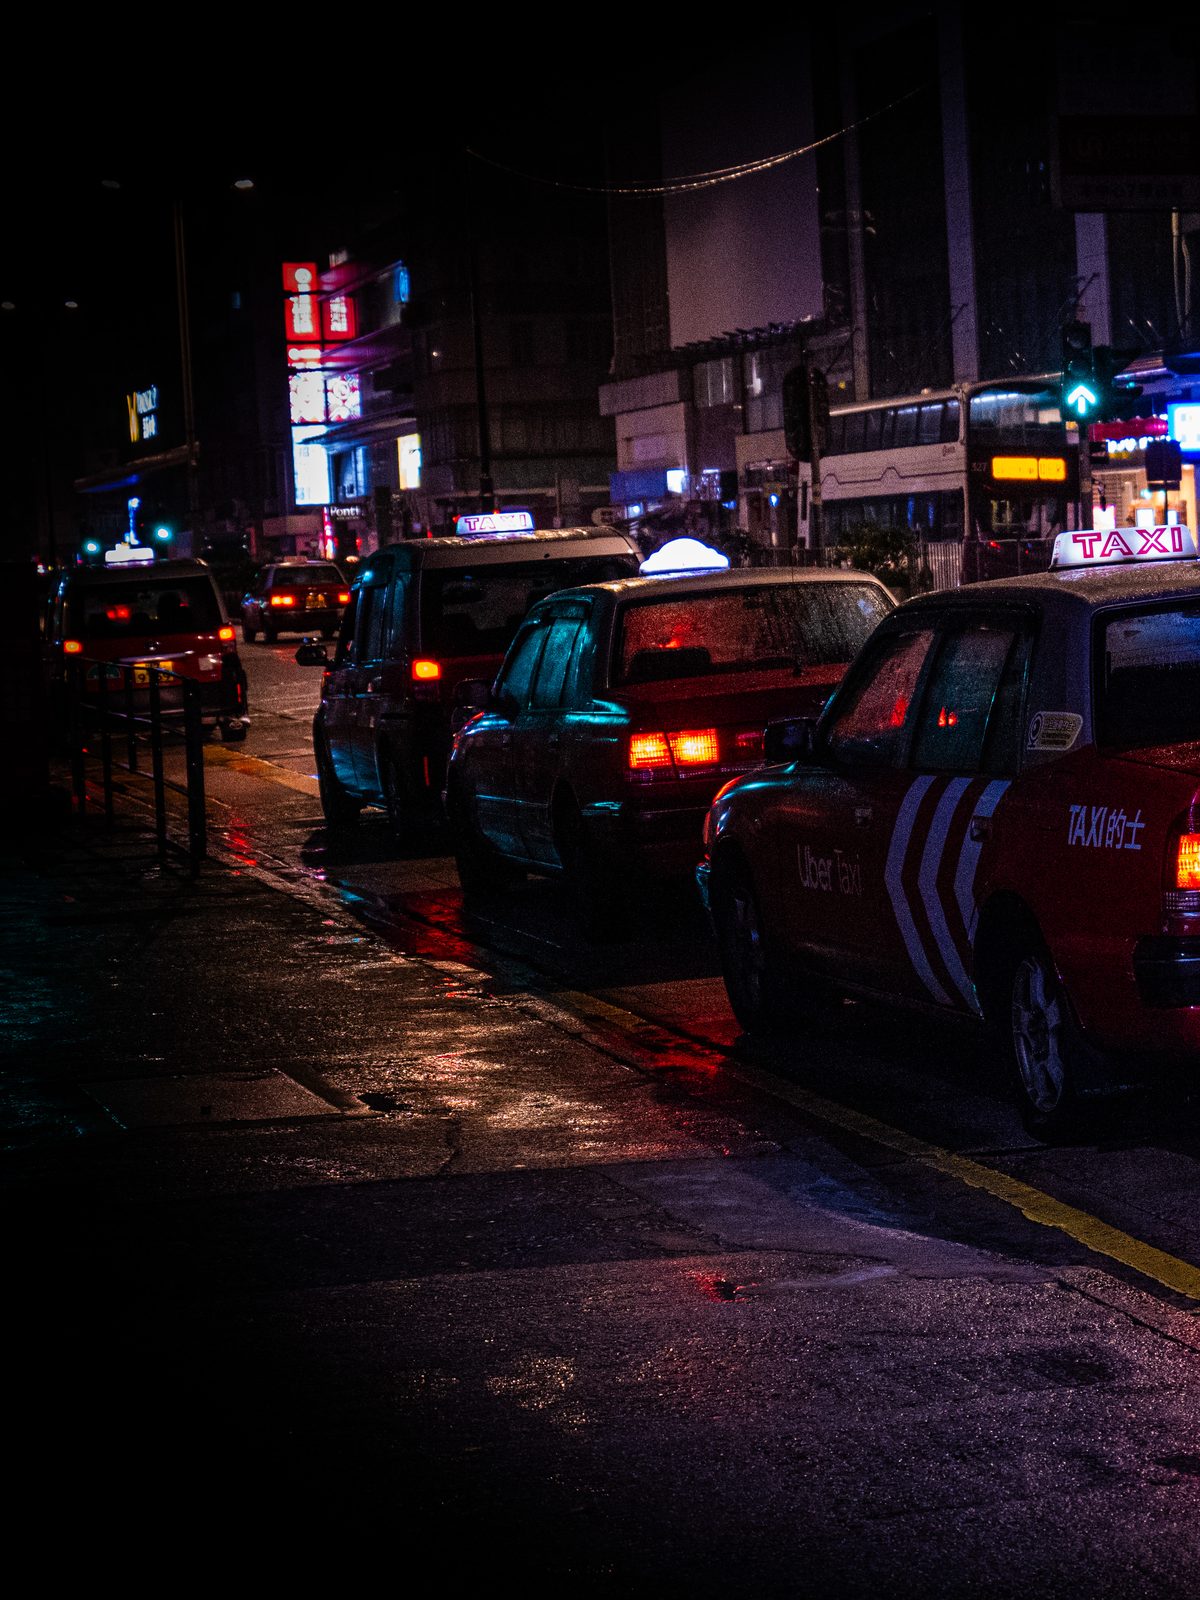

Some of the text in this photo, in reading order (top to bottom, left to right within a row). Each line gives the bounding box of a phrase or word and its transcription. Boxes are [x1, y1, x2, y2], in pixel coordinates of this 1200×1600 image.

[1072, 526, 1185, 560] TAXI
[796, 843, 865, 897] Uber Taxi
